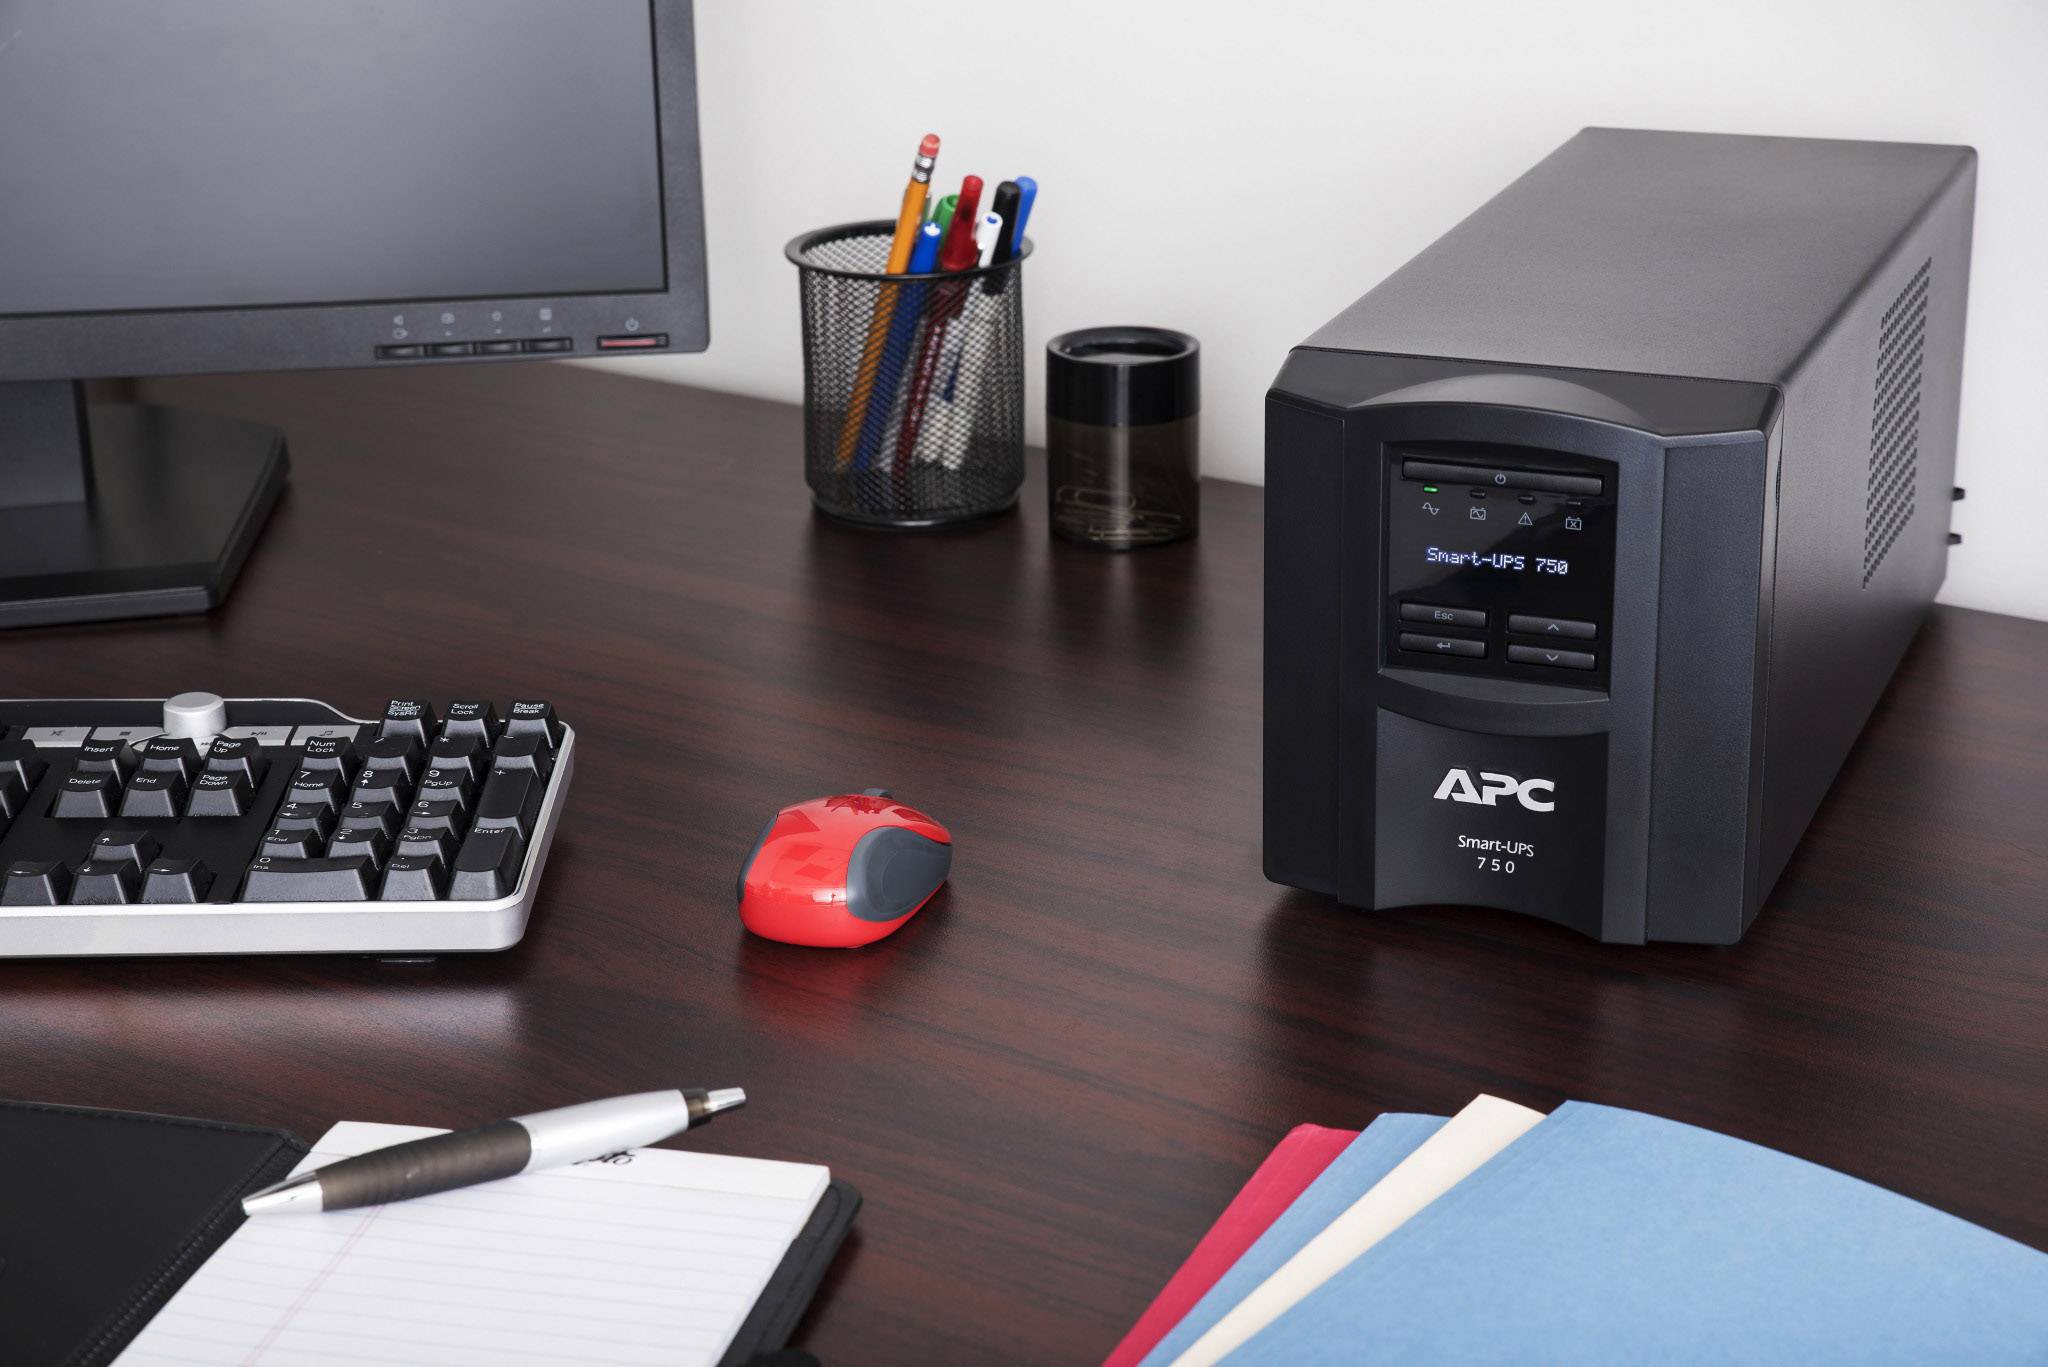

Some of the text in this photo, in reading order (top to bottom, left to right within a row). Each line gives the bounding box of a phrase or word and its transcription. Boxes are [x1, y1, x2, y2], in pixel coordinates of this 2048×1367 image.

[1426, 547, 1569, 576] Smart-UPS 750
[1434, 611, 1454, 621] Esc
[216, 740, 242, 748] Page
[300, 770, 311, 778] 7
[363, 770, 374, 778] 8
[428, 770, 440, 778] 9
[424, 779, 453, 787] PgUp
[1433, 768, 1555, 812] APC
[1457, 834, 1535, 857] Smart-UPS
